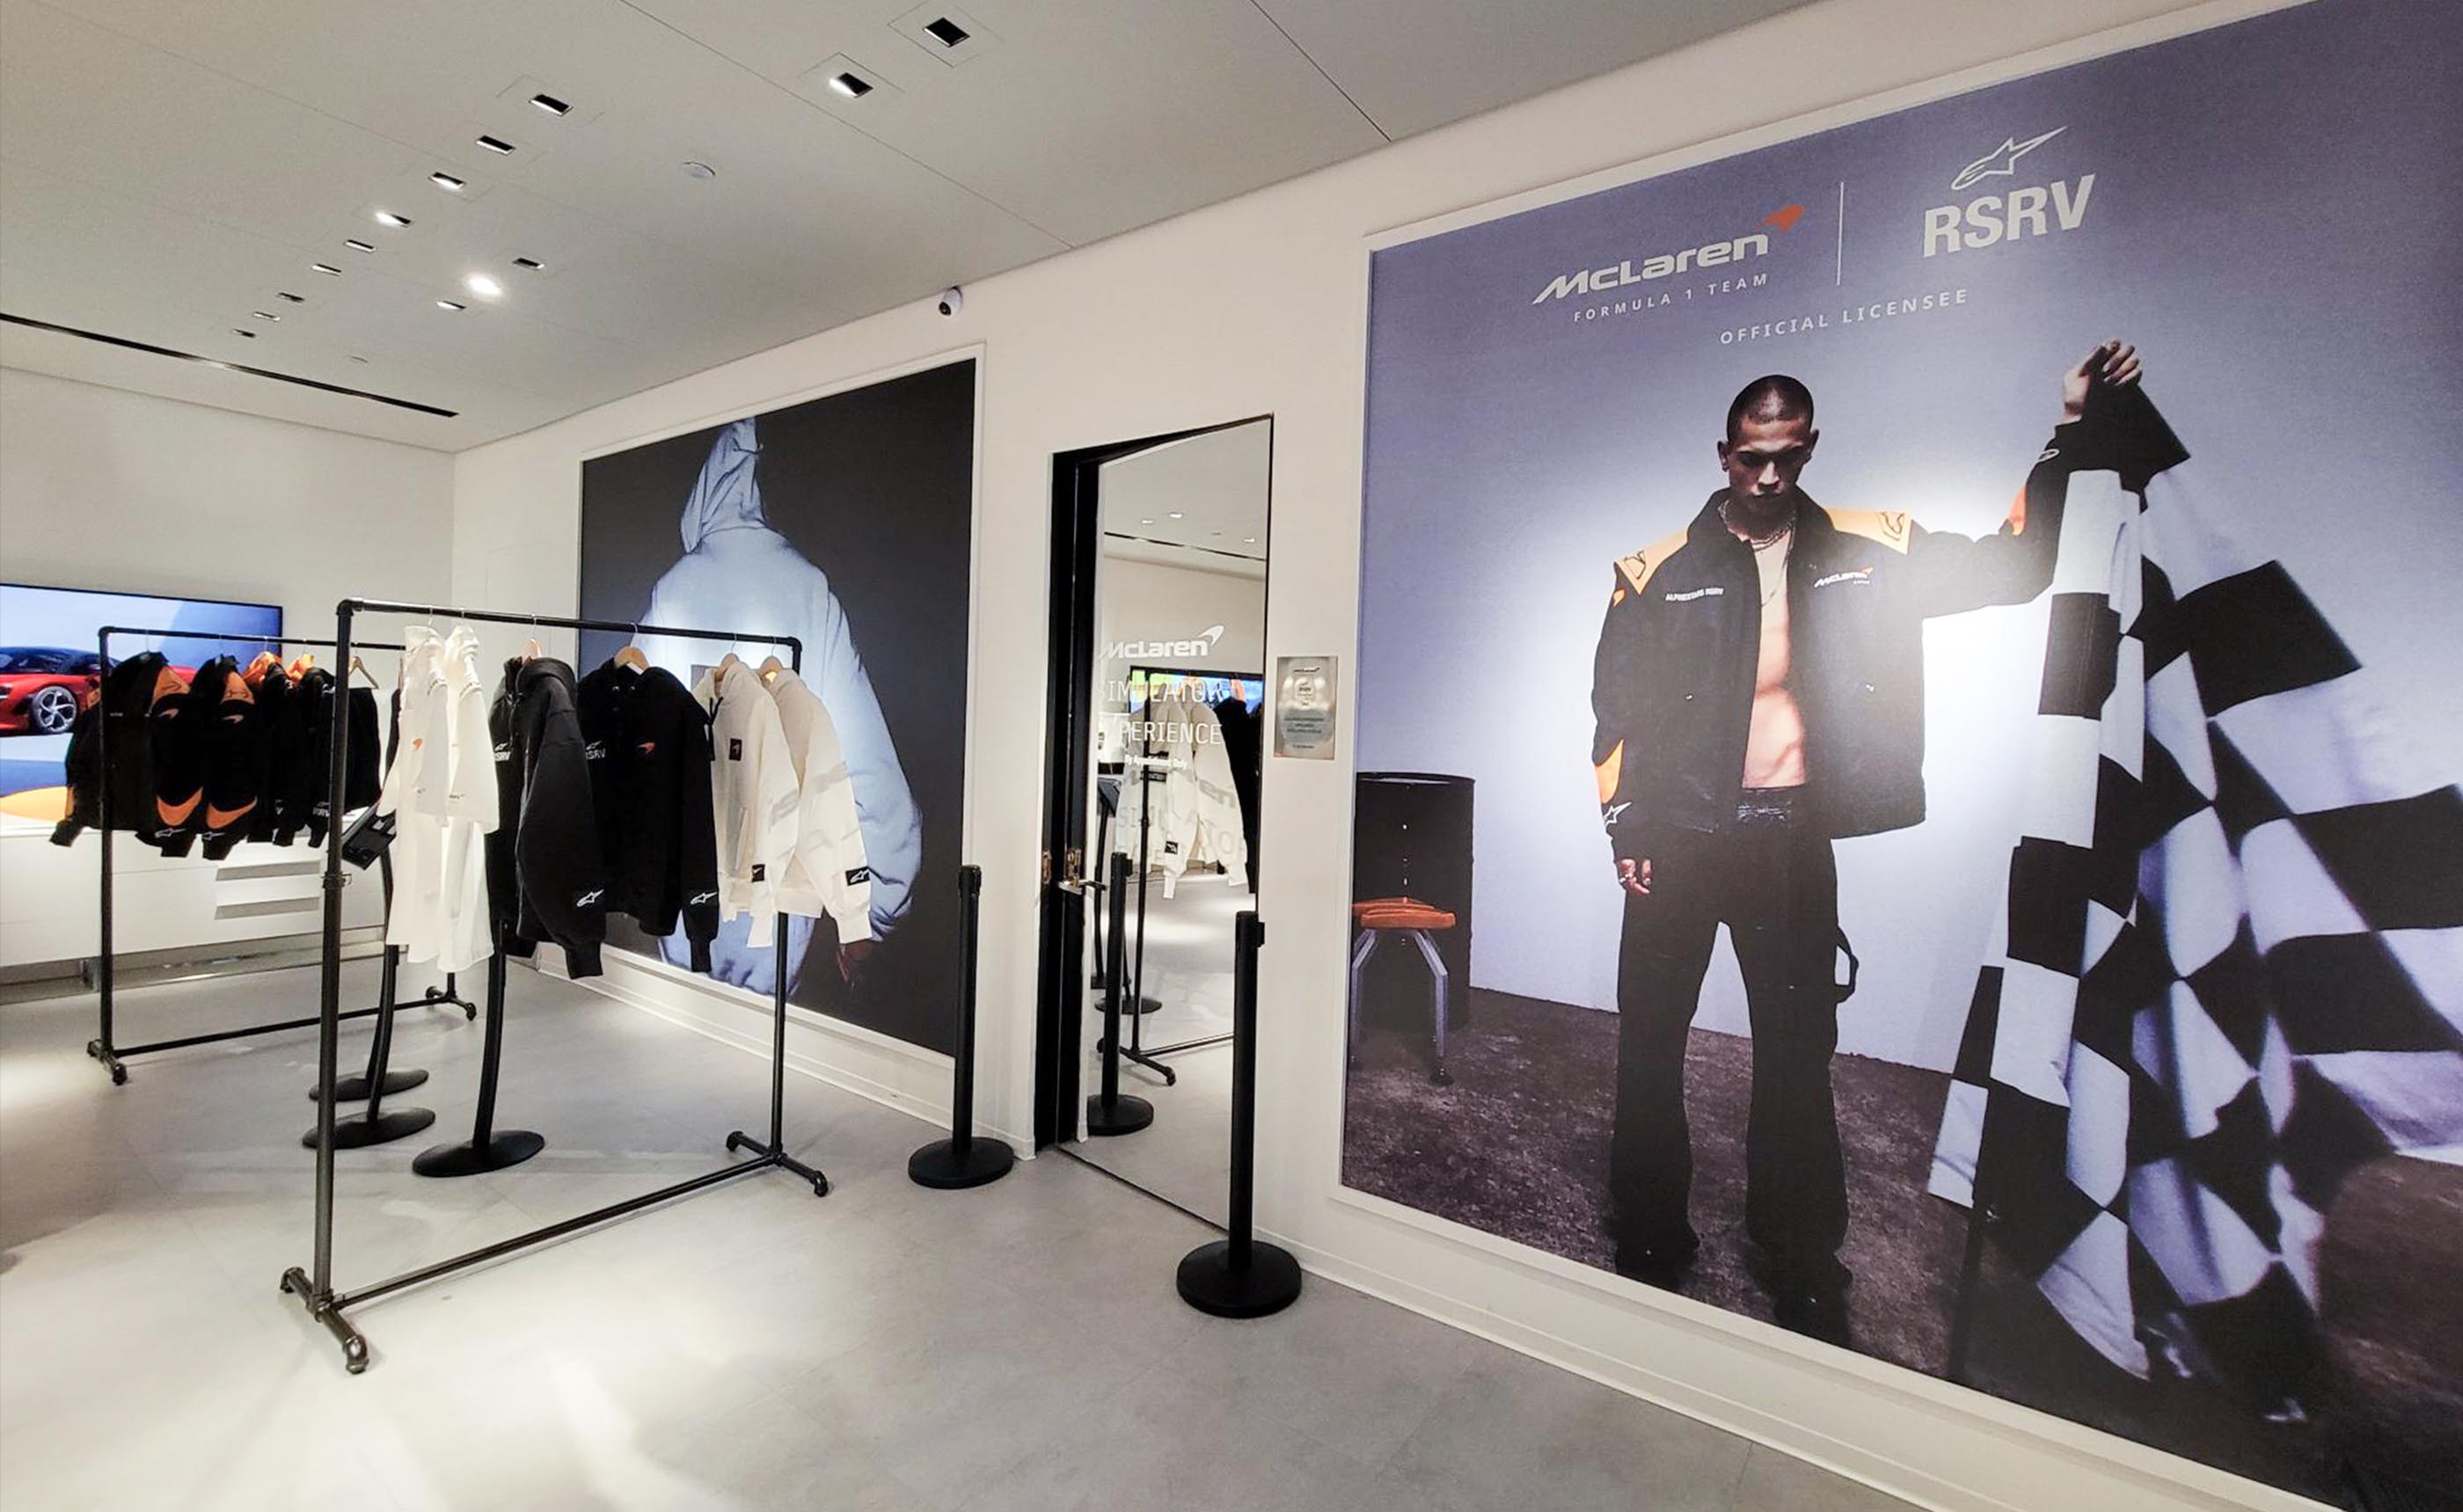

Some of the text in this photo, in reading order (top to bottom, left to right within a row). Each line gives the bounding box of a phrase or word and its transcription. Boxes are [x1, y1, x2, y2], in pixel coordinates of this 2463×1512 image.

[1922, 173, 2096, 258] RSRV
[1531, 231, 1769, 305] McLaren
[1574, 274, 1768, 322] FORMULA 1 TEAM
[1720, 289, 1969, 345] OFFICIAL LICENSEE
